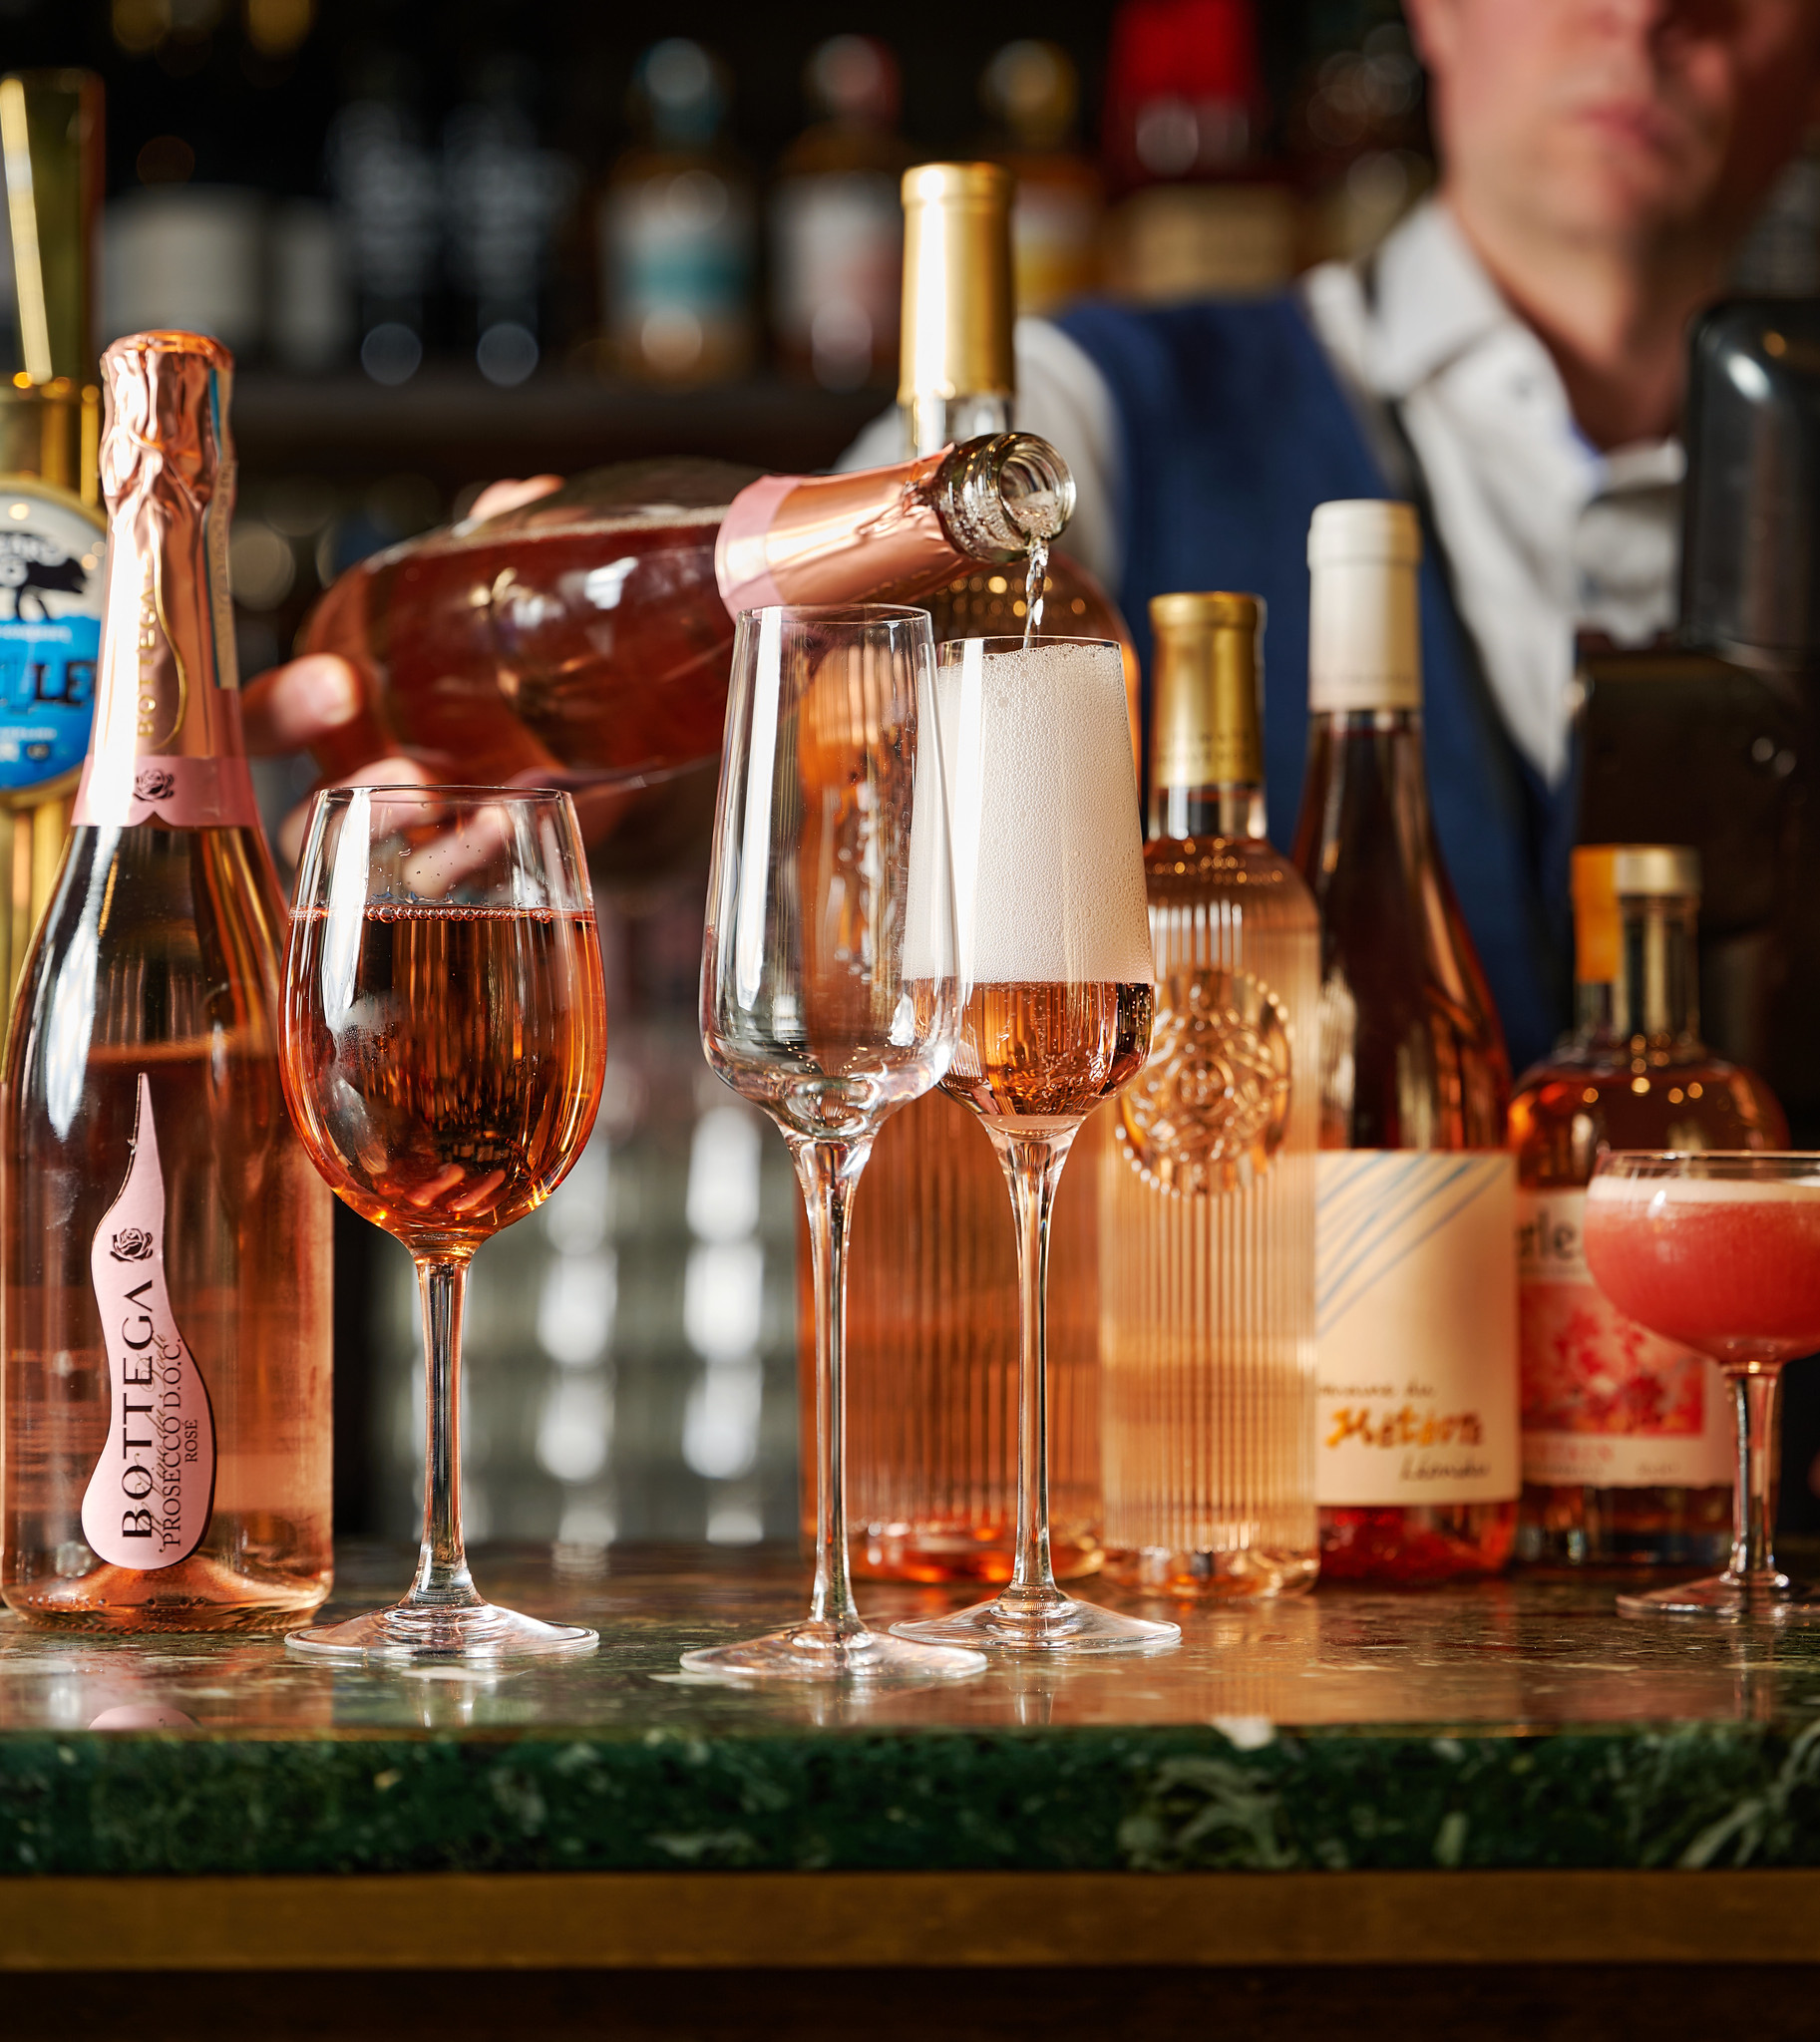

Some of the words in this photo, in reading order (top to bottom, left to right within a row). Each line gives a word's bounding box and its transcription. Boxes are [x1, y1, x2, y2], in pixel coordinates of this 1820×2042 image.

[137, 588, 157, 738] BOTTEGA
[122, 1279, 154, 1538] BOTTEGA
[162, 1338, 182, 1410] D.O.C.
[145, 1404, 167, 1440] dei
[182, 1420, 198, 1464] ROSÉ
[134, 1443, 166, 1499] Vino
[162, 1416, 182, 1547] PROSECCO
